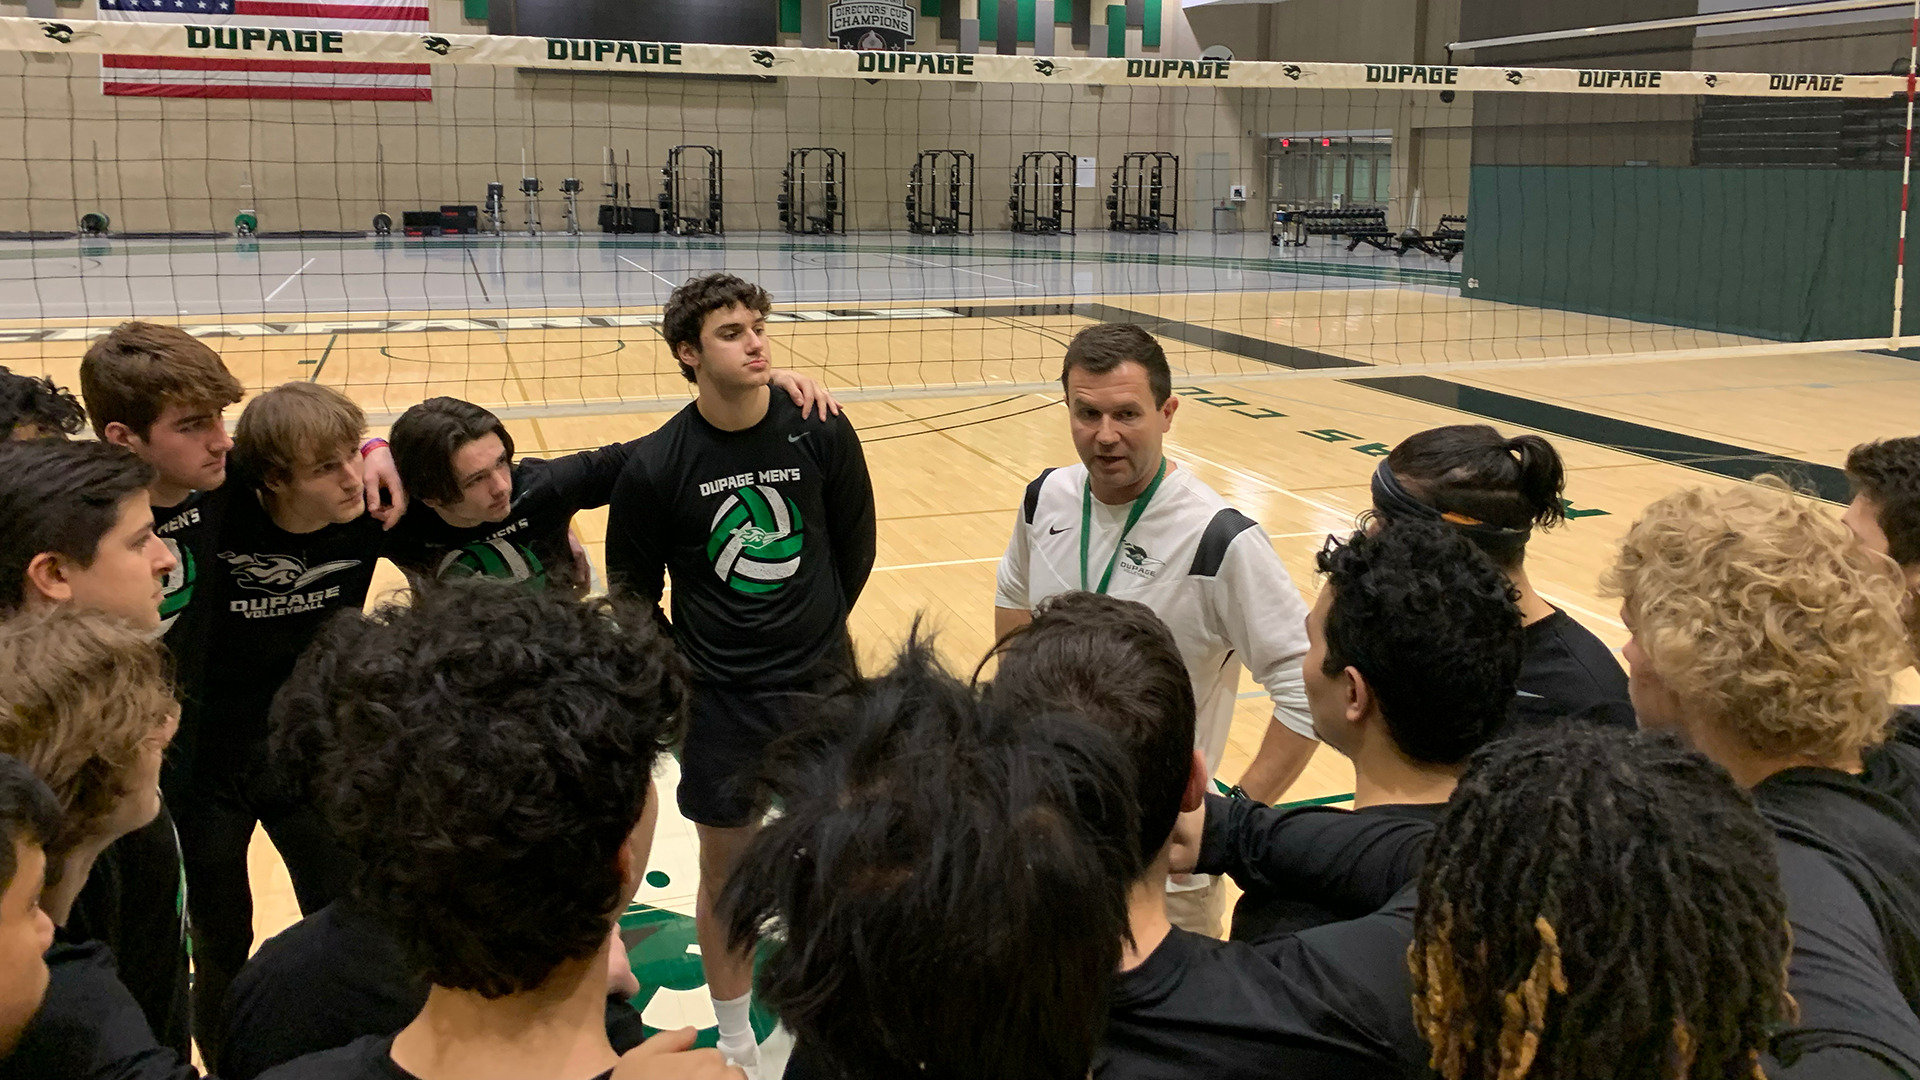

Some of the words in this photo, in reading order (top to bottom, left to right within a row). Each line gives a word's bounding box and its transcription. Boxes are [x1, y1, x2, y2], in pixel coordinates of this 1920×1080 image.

[835, 4, 888, 18] DIRECTORS'
[890, 8, 908, 20] CUP
[833, 14, 909, 32] CHAMPIONS
[187, 25, 343, 54] DUPAGE
[547, 38, 682, 65] DUPAGE
[857, 51, 974, 75] DUPAGE
[1126, 58, 1230, 80] DUPAGE
[1365, 63, 1458, 84] DUPAGE
[1578, 69, 1662, 89] DUPAGE
[1769, 73, 1843, 92] DUPAGE
[699, 473, 755, 498] DUPAGE
[758, 468, 801, 484] MEN'S
[1120, 561, 1157, 578] DUPAGE
[229, 585, 340, 612] DUPAGE
[243, 601, 326, 619] VOLLEYBALL
